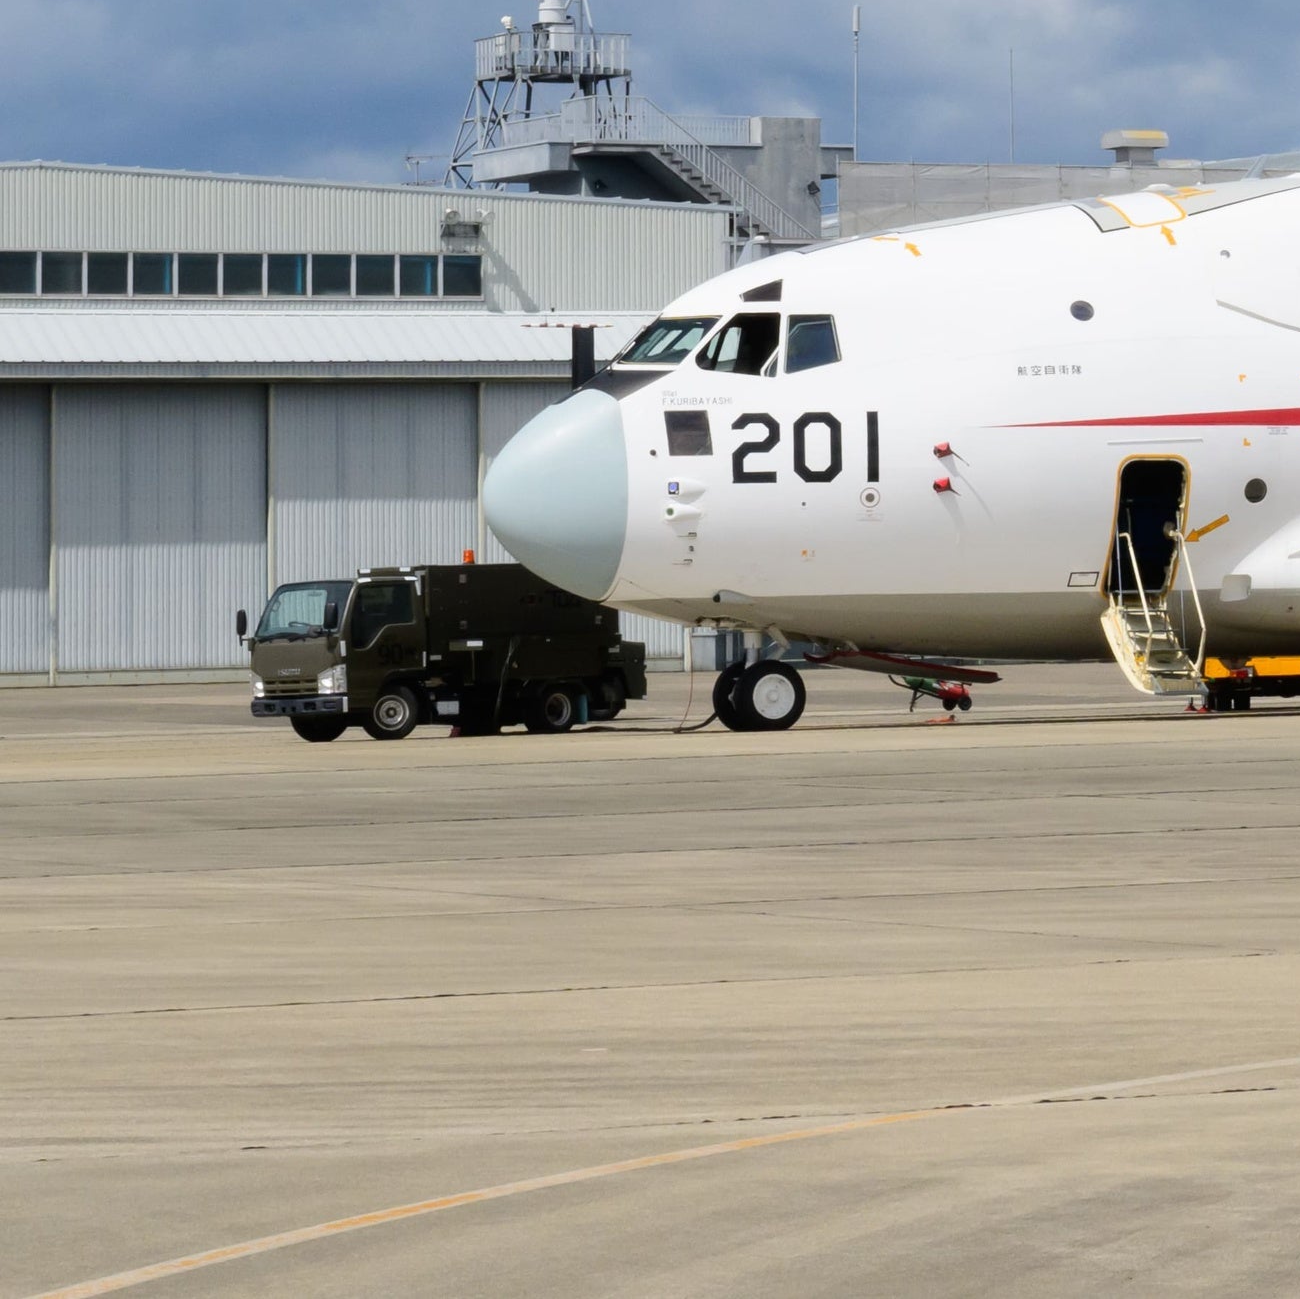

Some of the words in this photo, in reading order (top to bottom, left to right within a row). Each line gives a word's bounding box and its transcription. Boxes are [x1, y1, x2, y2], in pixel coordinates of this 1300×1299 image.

[1017, 365, 1082, 376] 航空自衛隊
[731, 411, 879, 483] 201
